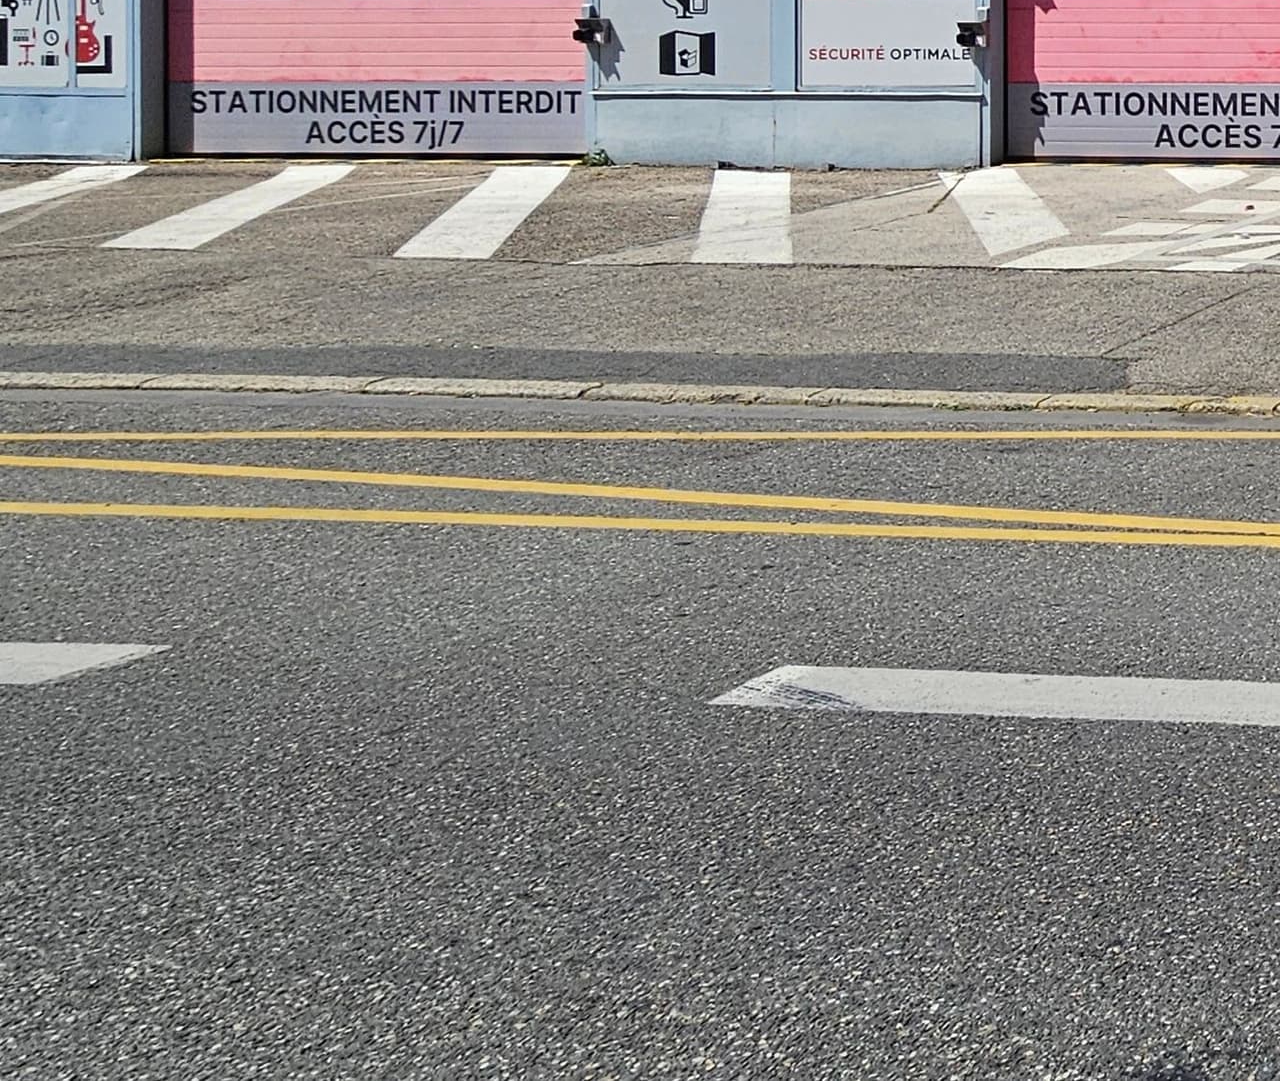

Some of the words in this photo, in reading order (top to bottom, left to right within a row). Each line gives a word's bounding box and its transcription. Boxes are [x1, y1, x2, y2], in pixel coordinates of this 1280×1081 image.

[809, 45, 885, 60] SÉCURITÉ
[890, 48, 971, 60] OPTIMALE
[191, 90, 441, 114] STATIONNEMENT
[450, 90, 582, 114] INTERDIT
[305, 114, 405, 144] ACCÈS
[412, 120, 464, 150] 7j/7
[1154, 117, 1262, 149] ACCÈS
